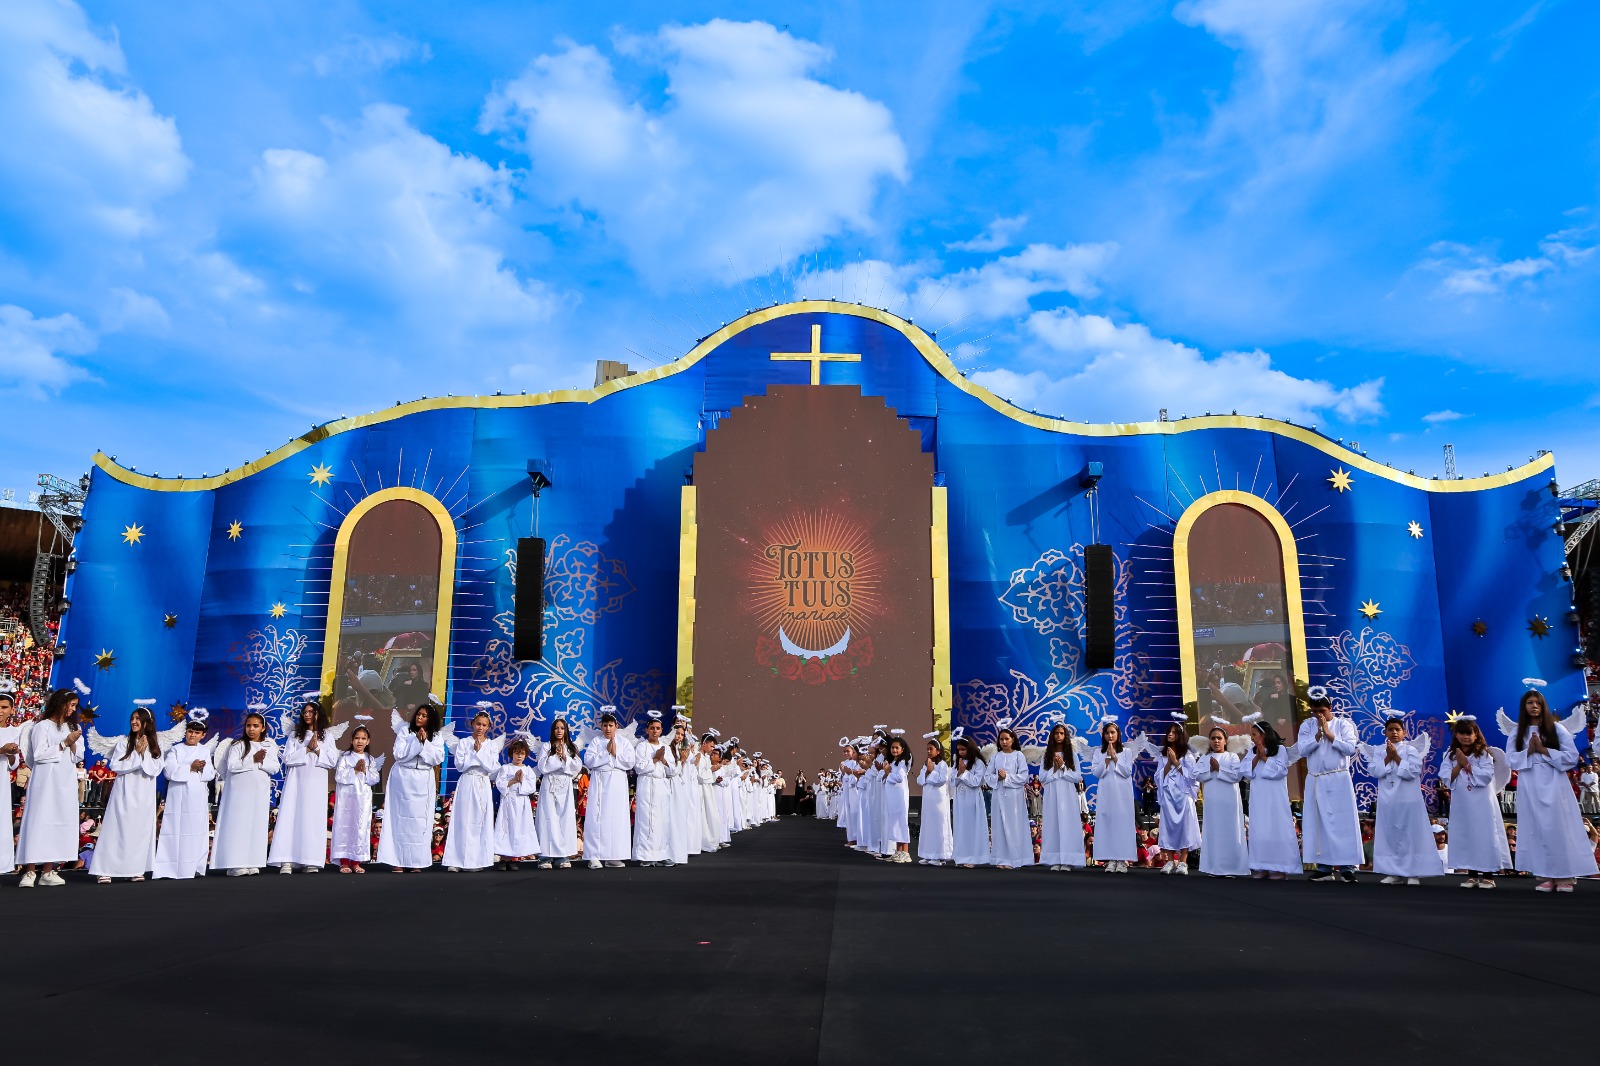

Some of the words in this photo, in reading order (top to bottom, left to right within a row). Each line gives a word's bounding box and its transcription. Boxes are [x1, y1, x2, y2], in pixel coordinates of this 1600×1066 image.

[765, 539, 855, 580] TOTUS
[783, 580, 851, 608] TUUS
[780, 609, 851, 621] mariae
